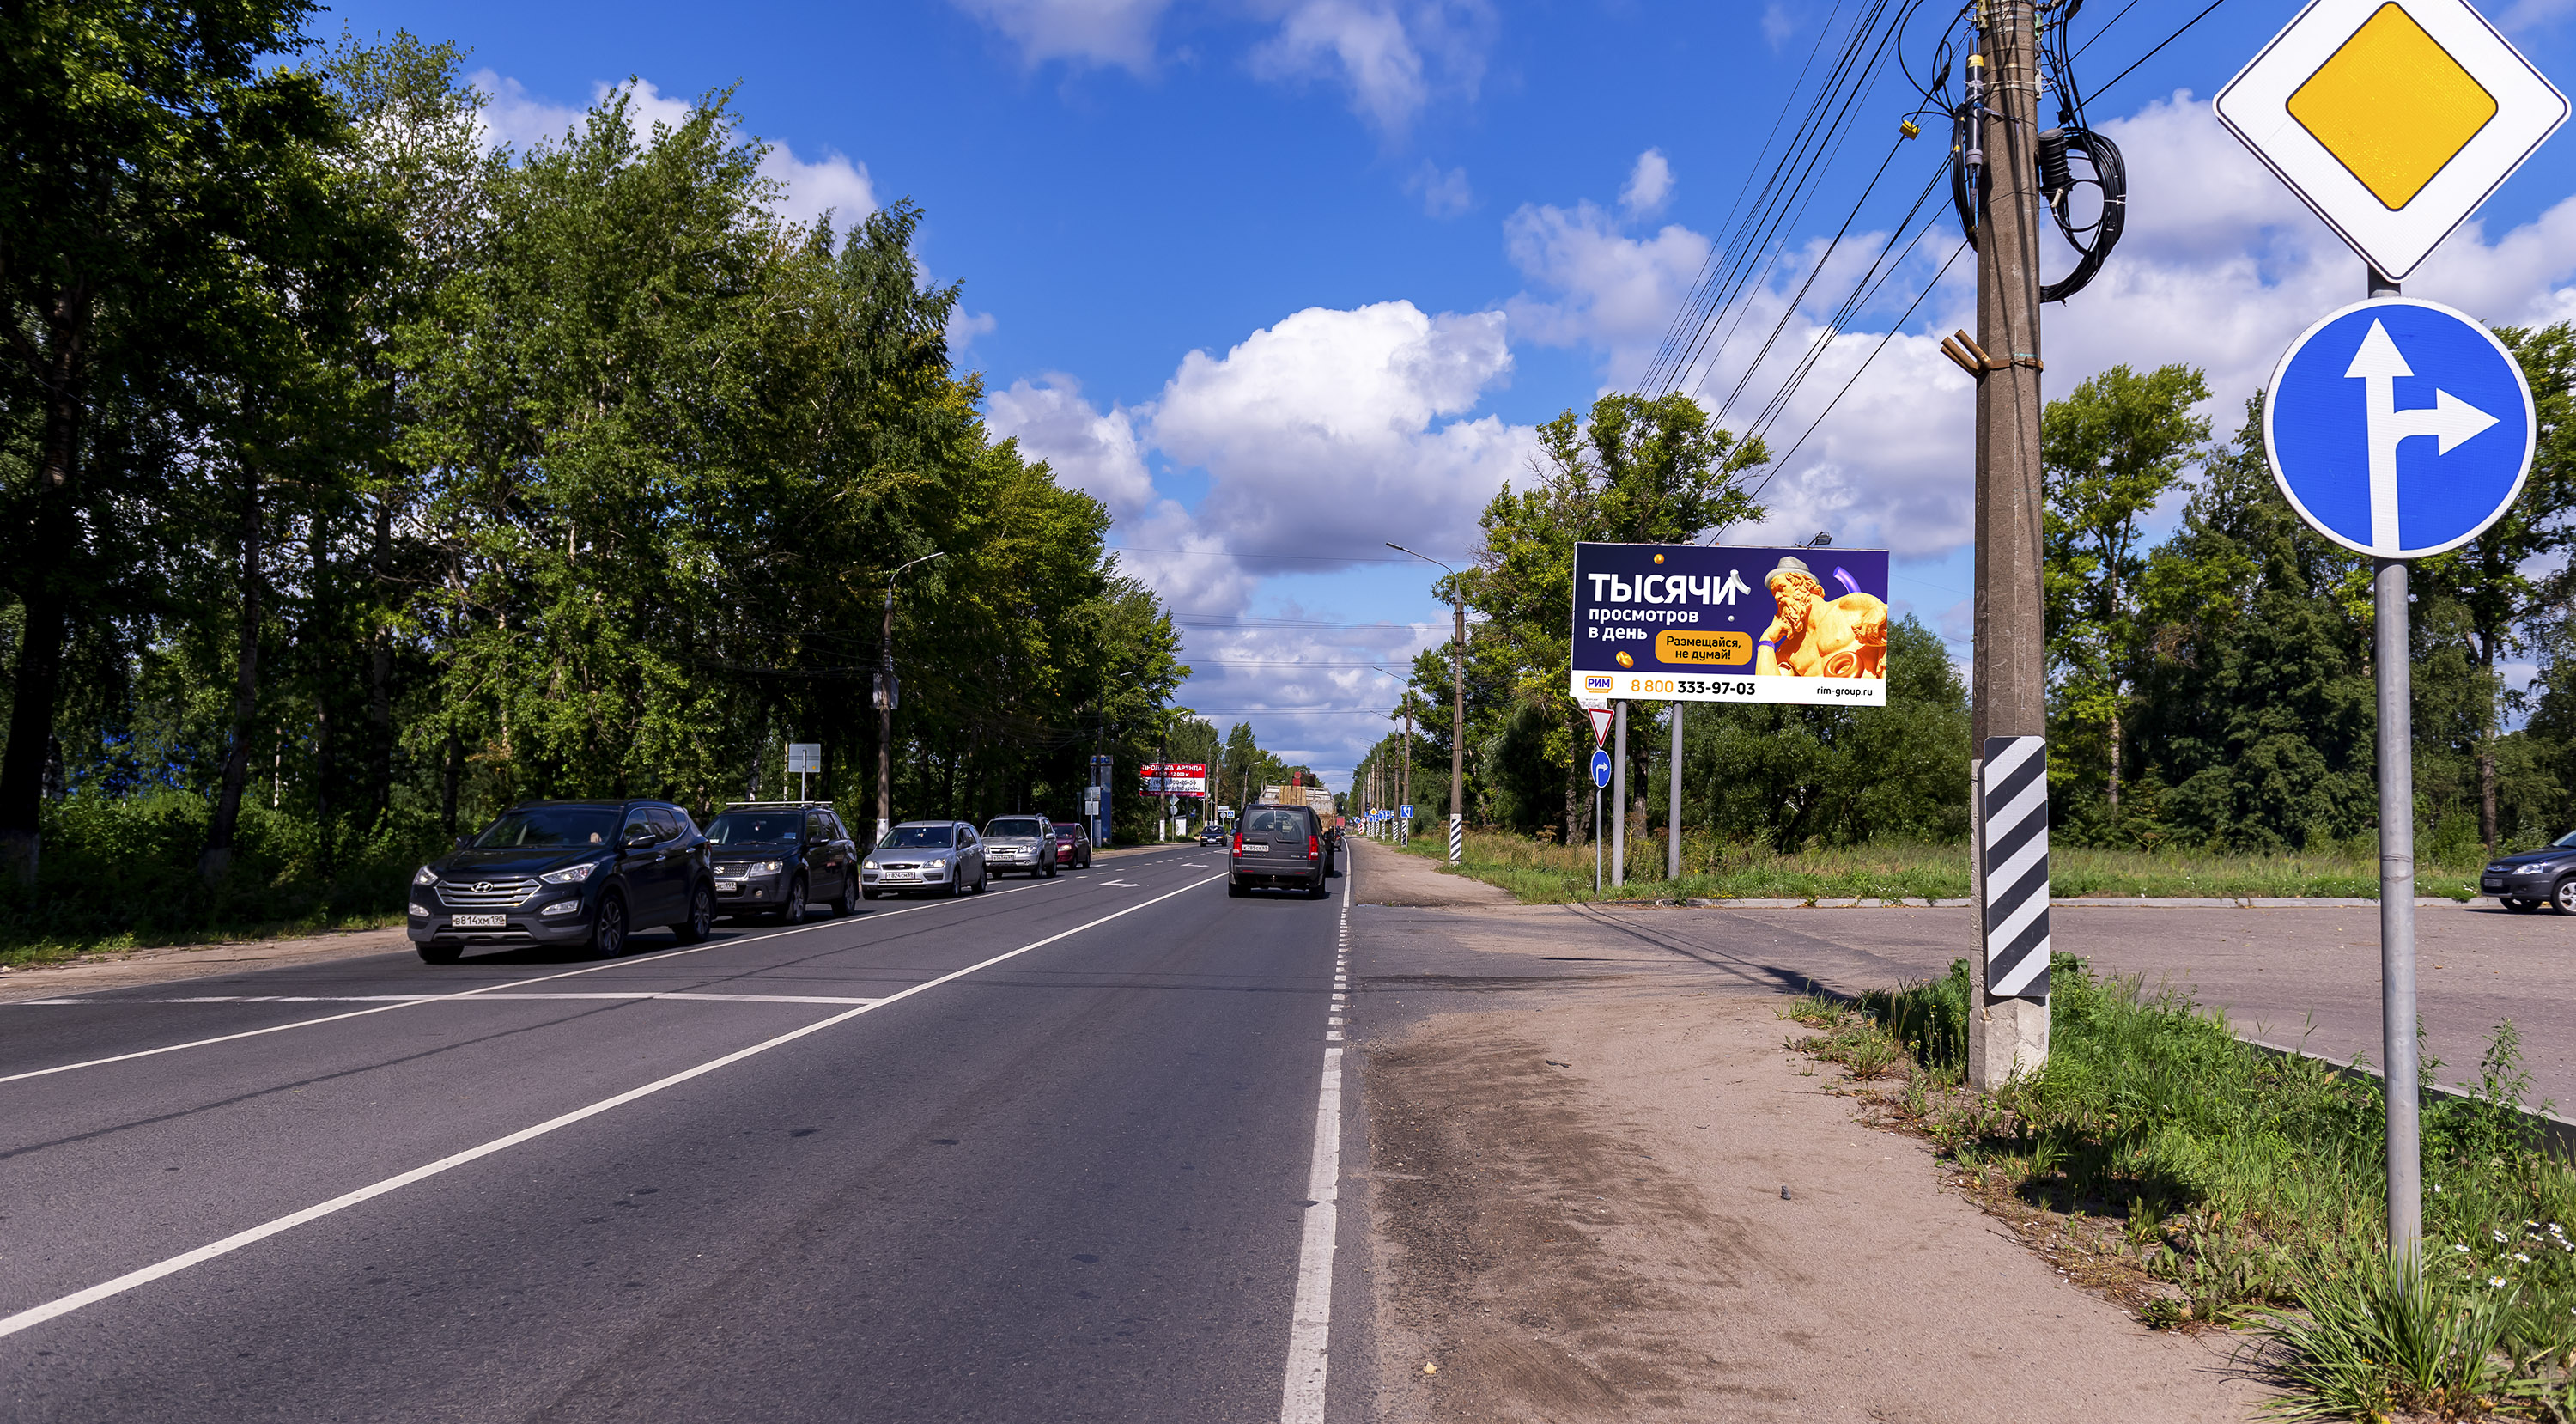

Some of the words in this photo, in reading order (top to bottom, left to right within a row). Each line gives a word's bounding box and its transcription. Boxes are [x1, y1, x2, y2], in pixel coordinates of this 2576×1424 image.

[1588, 573, 1736, 606] ТЫСЯЧИ
[1589, 608, 1699, 626] просмотров
[1588, 626, 1599, 638] в
[1601, 627, 1648, 642] день
[1666, 636, 1741, 649] Размещайся,
[1675, 650, 1689, 659] не
[1691, 649, 1731, 661] думай!
[1588, 679, 1610, 688] РИМ
[1631, 679, 1640, 692] 8
[1644, 679, 1674, 693] 800
[1677, 680, 1756, 696] 333-97-03
[1816, 685, 1873, 697] rim-group.ru
